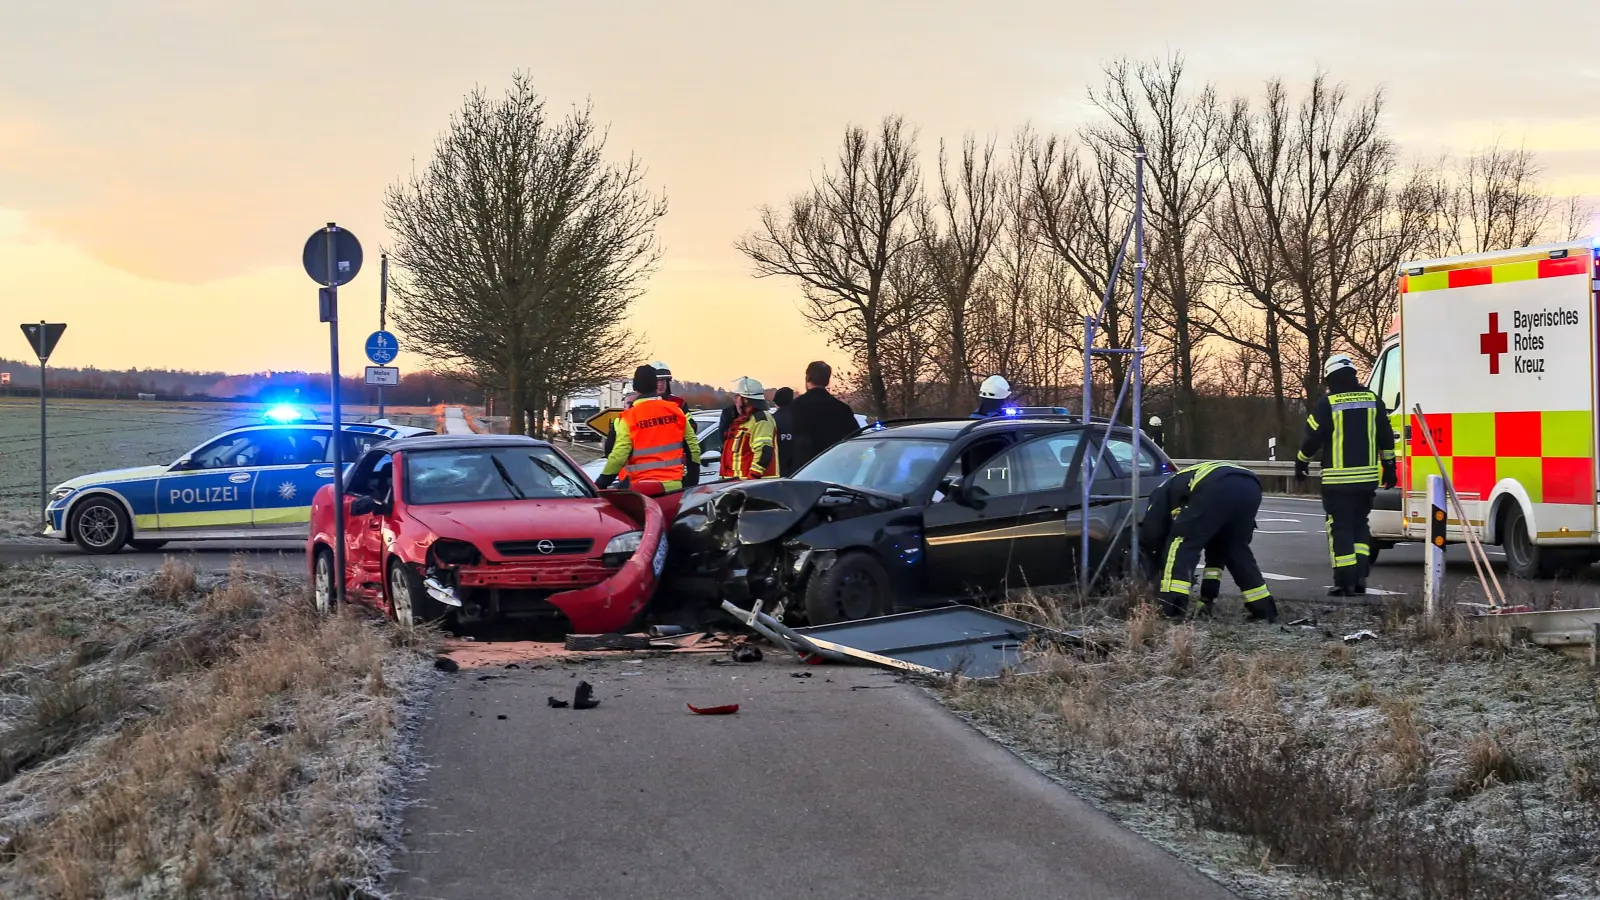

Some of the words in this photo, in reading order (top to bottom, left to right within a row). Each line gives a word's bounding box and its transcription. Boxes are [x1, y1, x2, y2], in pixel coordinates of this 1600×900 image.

[1513, 307, 1578, 332] Bayerisches
[1514, 333, 1544, 351] Rotes
[1514, 355, 1545, 373] Kreuz
[169, 486, 239, 504] POLIZEI
